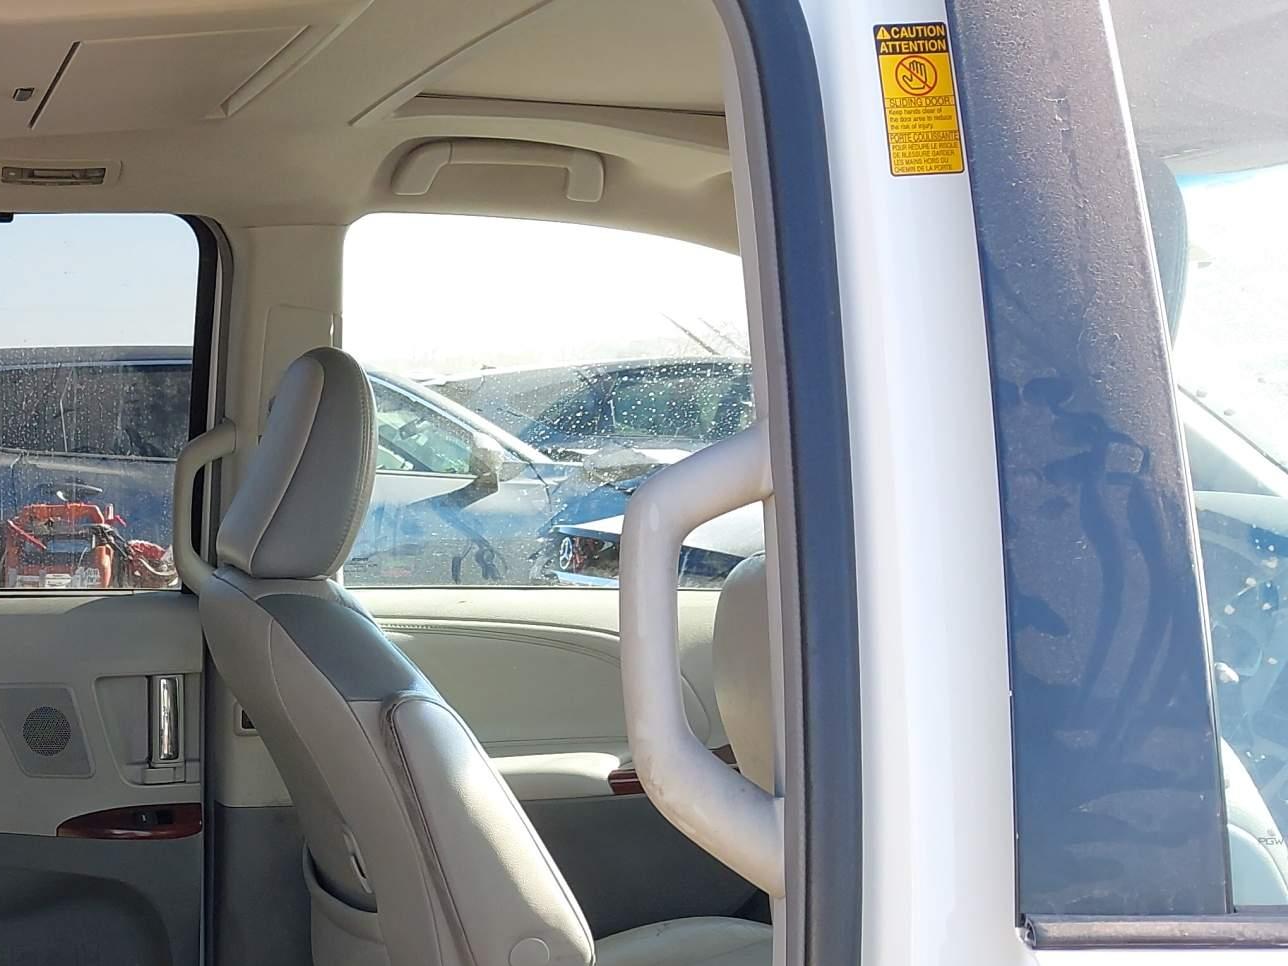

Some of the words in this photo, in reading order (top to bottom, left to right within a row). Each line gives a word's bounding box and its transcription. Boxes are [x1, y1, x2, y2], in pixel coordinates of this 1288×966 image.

[891, 25, 945, 38] CAUTION
[880, 39, 947, 53] ATTENTION
[889, 97, 923, 107] SLIDING
[925, 96, 950, 106] DOOR
[890, 133, 913, 144] PORTE
[913, 132, 959, 143] COULISSANTE
